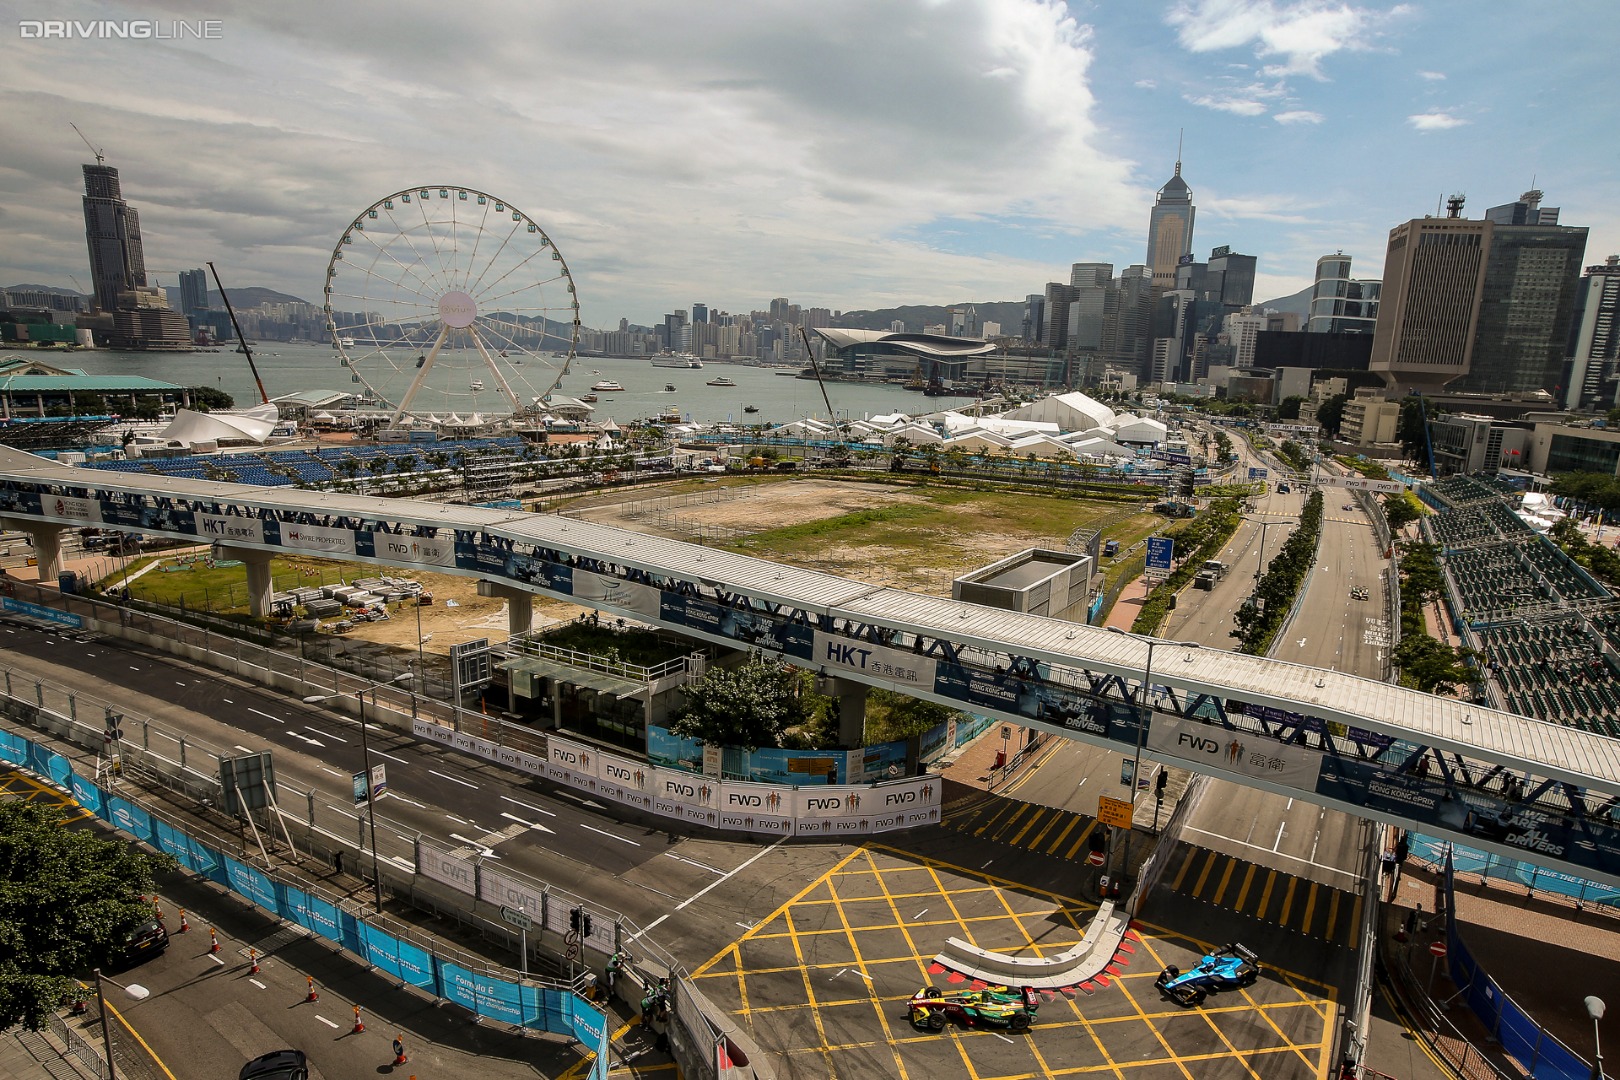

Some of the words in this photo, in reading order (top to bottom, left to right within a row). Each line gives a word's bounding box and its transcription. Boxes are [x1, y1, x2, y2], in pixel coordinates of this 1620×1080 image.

[1345, 480, 1360, 488] FWD
[1376, 483, 1392, 491] FWD
[203, 518, 227, 534] HKT
[388, 543, 408, 554] FWD
[755, 624, 770, 633] ARE
[761, 618, 773, 628] WE
[755, 636, 783, 650] DRIVERS
[763, 632, 776, 641] ALL
[827, 641, 872, 669] HKT
[871, 661, 918, 682] 香港電訊
[970, 683, 985, 692] HONG
[985, 687, 1000, 696] KONG
[1066, 702, 1086, 713] ARE
[1076, 696, 1093, 707] WE
[1065, 717, 1105, 734] DRIVERS
[1077, 713, 1095, 724] ALL
[1178, 732, 1219, 754] FWD
[1249, 752, 1286, 773] 富衛
[414, 724, 425, 732] FWD
[435, 732, 446, 740] FWD
[457, 738, 468, 748] FWD
[478, 746, 490, 754] FWD
[502, 754, 514, 762] FWD
[524, 760, 538, 770] FWD
[550, 768, 562, 778] FWD
[574, 776, 588, 786] FWD
[600, 786, 614, 795] FWD
[627, 794, 642, 804] FWD
[656, 802, 672, 812] FWD
[688, 810, 705, 820] FWD
[722, 818, 742, 826] FWD
[760, 820, 779, 829] FWD
[836, 822, 856, 830] FWD
[875, 818, 894, 828] FWD
[909, 813, 927, 822] FWD
[553, 748, 576, 764] FWD
[606, 765, 631, 781] FWD
[666, 781, 694, 797] FWD
[729, 794, 762, 807] FWD
[808, 798, 840, 810] FWD
[886, 791, 916, 806] FWD
[1369, 784, 1390, 795] HONG
[1390, 789, 1412, 800] KONG
[1412, 795, 1435, 806] ePRIX
[1508, 815, 1539, 830] ARE
[1523, 810, 1549, 823] WE
[1523, 829, 1549, 843] ALL
[1505, 833, 1565, 855] DRIVERS
[1559, 873, 1577, 884] THE
[1577, 878, 1614, 892] FUTURE
[297, 904, 336, 929] #FanBoost
[385, 951, 396, 963] THE
[397, 958, 421, 974] FUTURE
[488, 986, 495, 995] E
